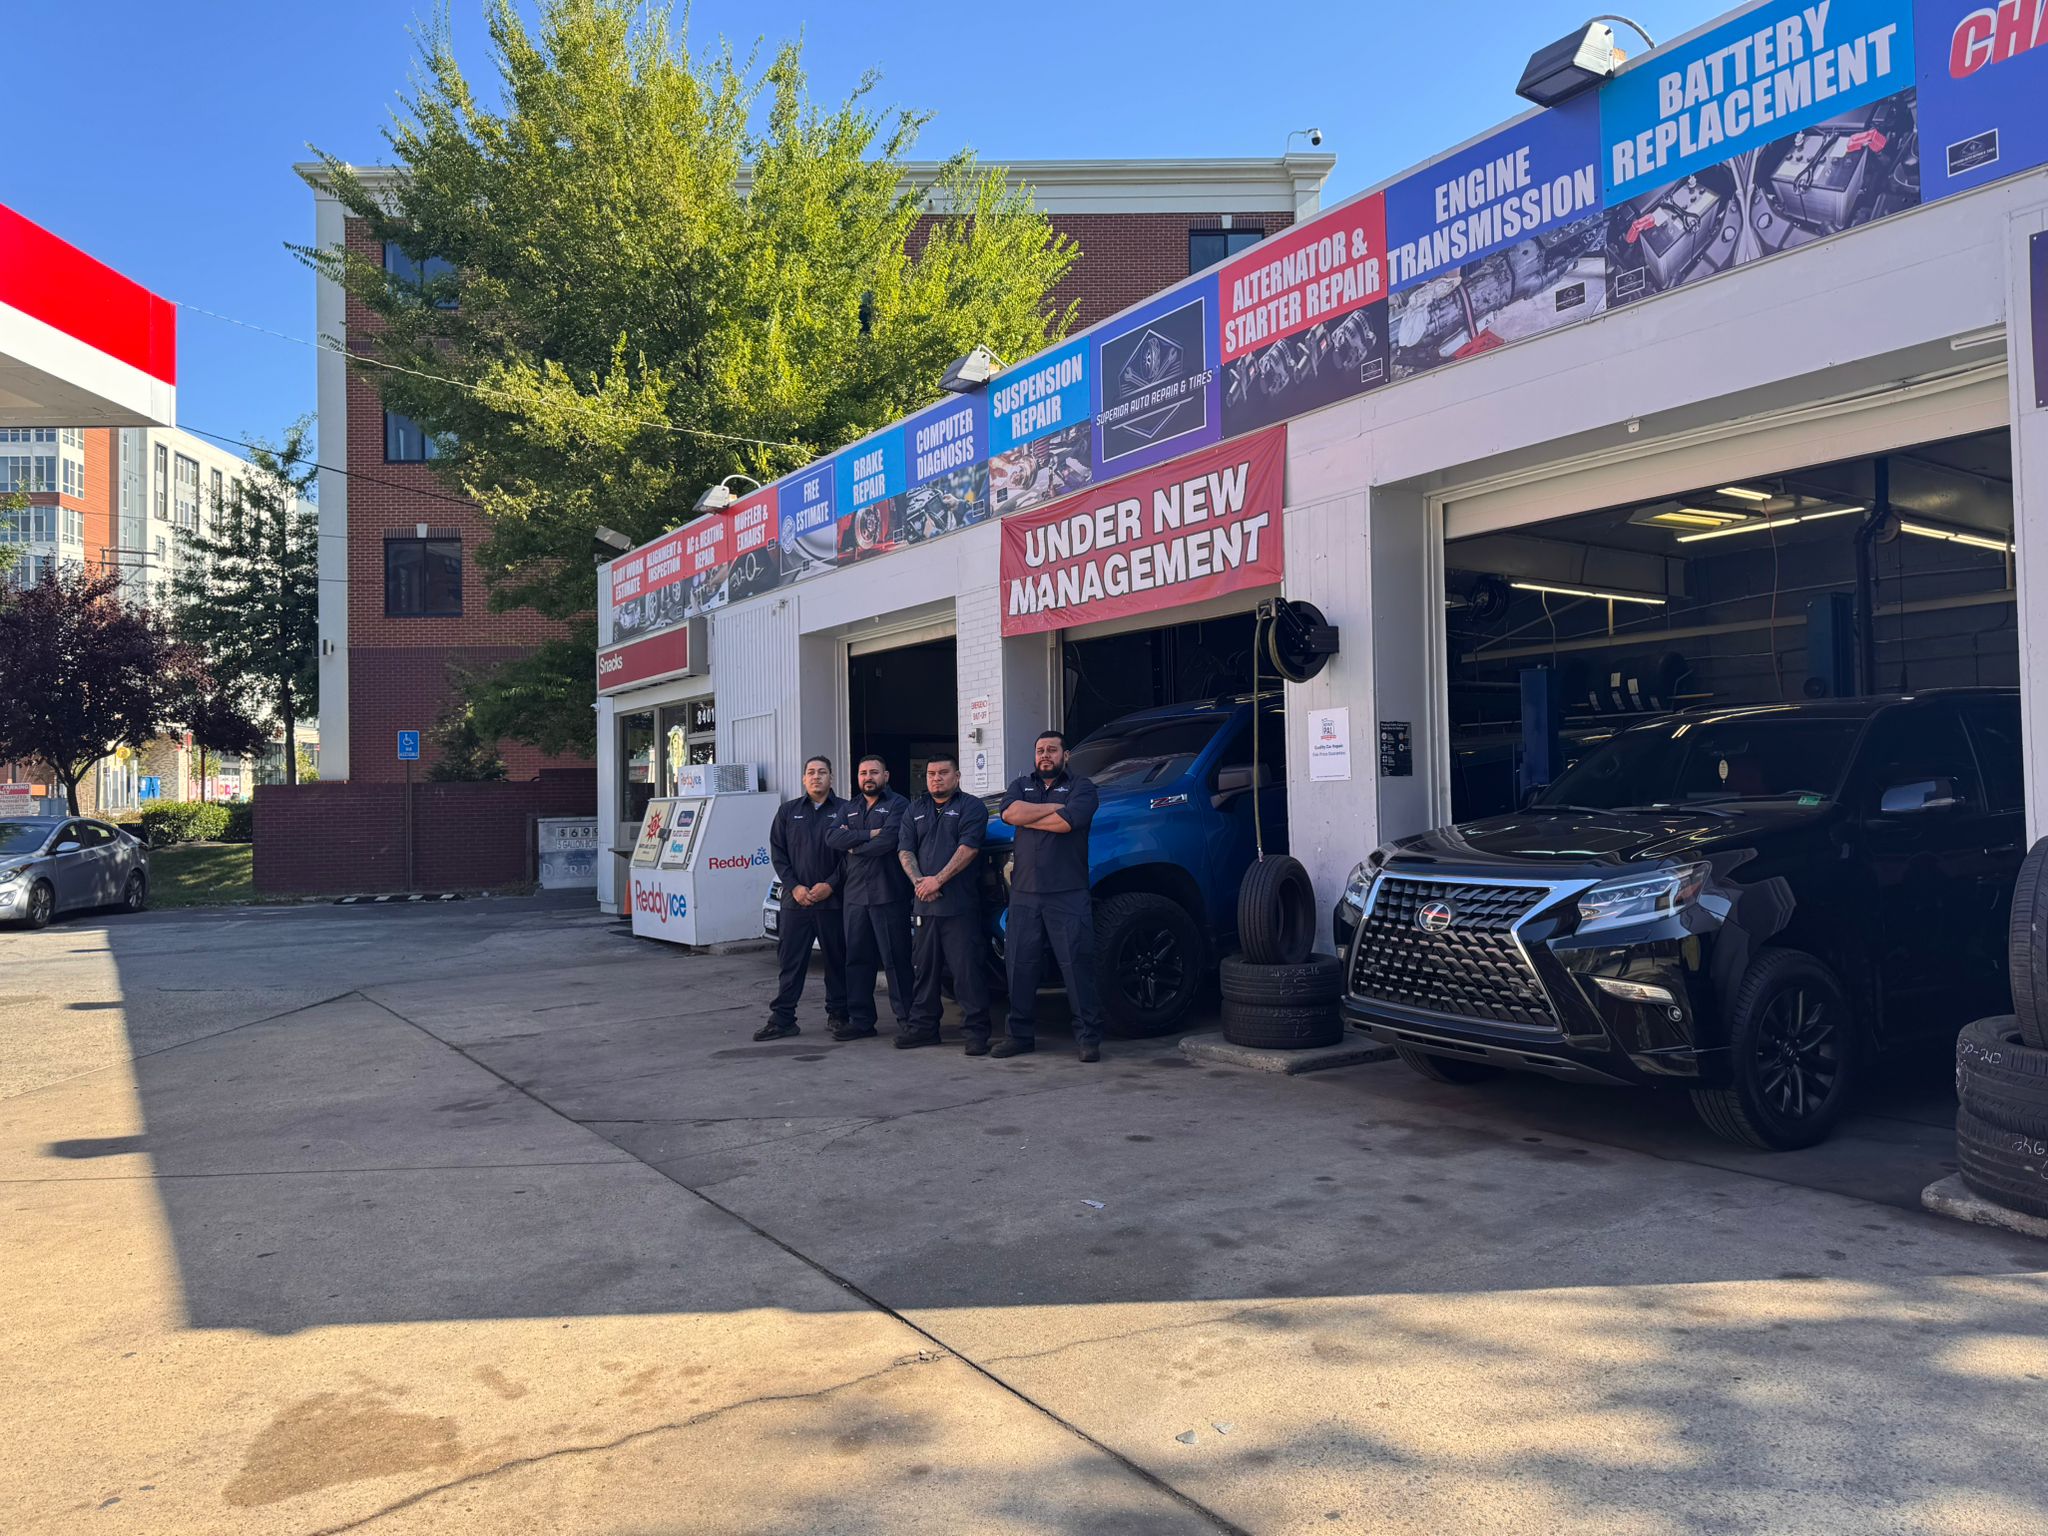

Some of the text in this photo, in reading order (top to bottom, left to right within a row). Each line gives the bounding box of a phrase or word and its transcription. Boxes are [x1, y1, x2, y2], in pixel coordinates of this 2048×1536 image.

[1659, 0, 1830, 119] BATTERY
[1612, 23, 1896, 186] REPLACEMENT
[1435, 146, 1530, 224] ENGINE
[1387, 164, 1595, 286] TRANSMISSION
[1233, 228, 1368, 313] ALTERNATOR &
[1225, 258, 1380, 353] STARTER REPAIR
[994, 353, 1083, 418] SUSPENSION
[1096, 402, 1129, 426] SUPERIOR
[1130, 394, 1150, 412] AUTO
[1151, 383, 1178, 405] REPAIR
[1189, 369, 1213, 389] TIRES
[916, 408, 973, 454] COMPUTER
[1011, 395, 1062, 440] REPAIR
[853, 448, 884, 483] BRAKE
[917, 435, 974, 480] DIAGNOSIS
[803, 478, 820, 503] FREE
[853, 473, 885, 506] REPAIR
[734, 504, 768, 533] MUFFLER &
[796, 501, 829, 532] ESTIMATE
[1025, 461, 1250, 568] UNDER NEW
[646, 541, 677, 568] ALIGNMENT
[687, 536, 695, 555] AC
[699, 522, 724, 548] HEATING
[736, 524, 766, 552] EXHAUST
[626, 557, 644, 578] WORK
[648, 556, 681, 583] INSPECTION
[695, 547, 715, 570] REPAIR
[1008, 512, 1269, 616] MANAGEMENT
[615, 577, 641, 601] ESTIMATE
[600, 653, 623, 675] Snacks
